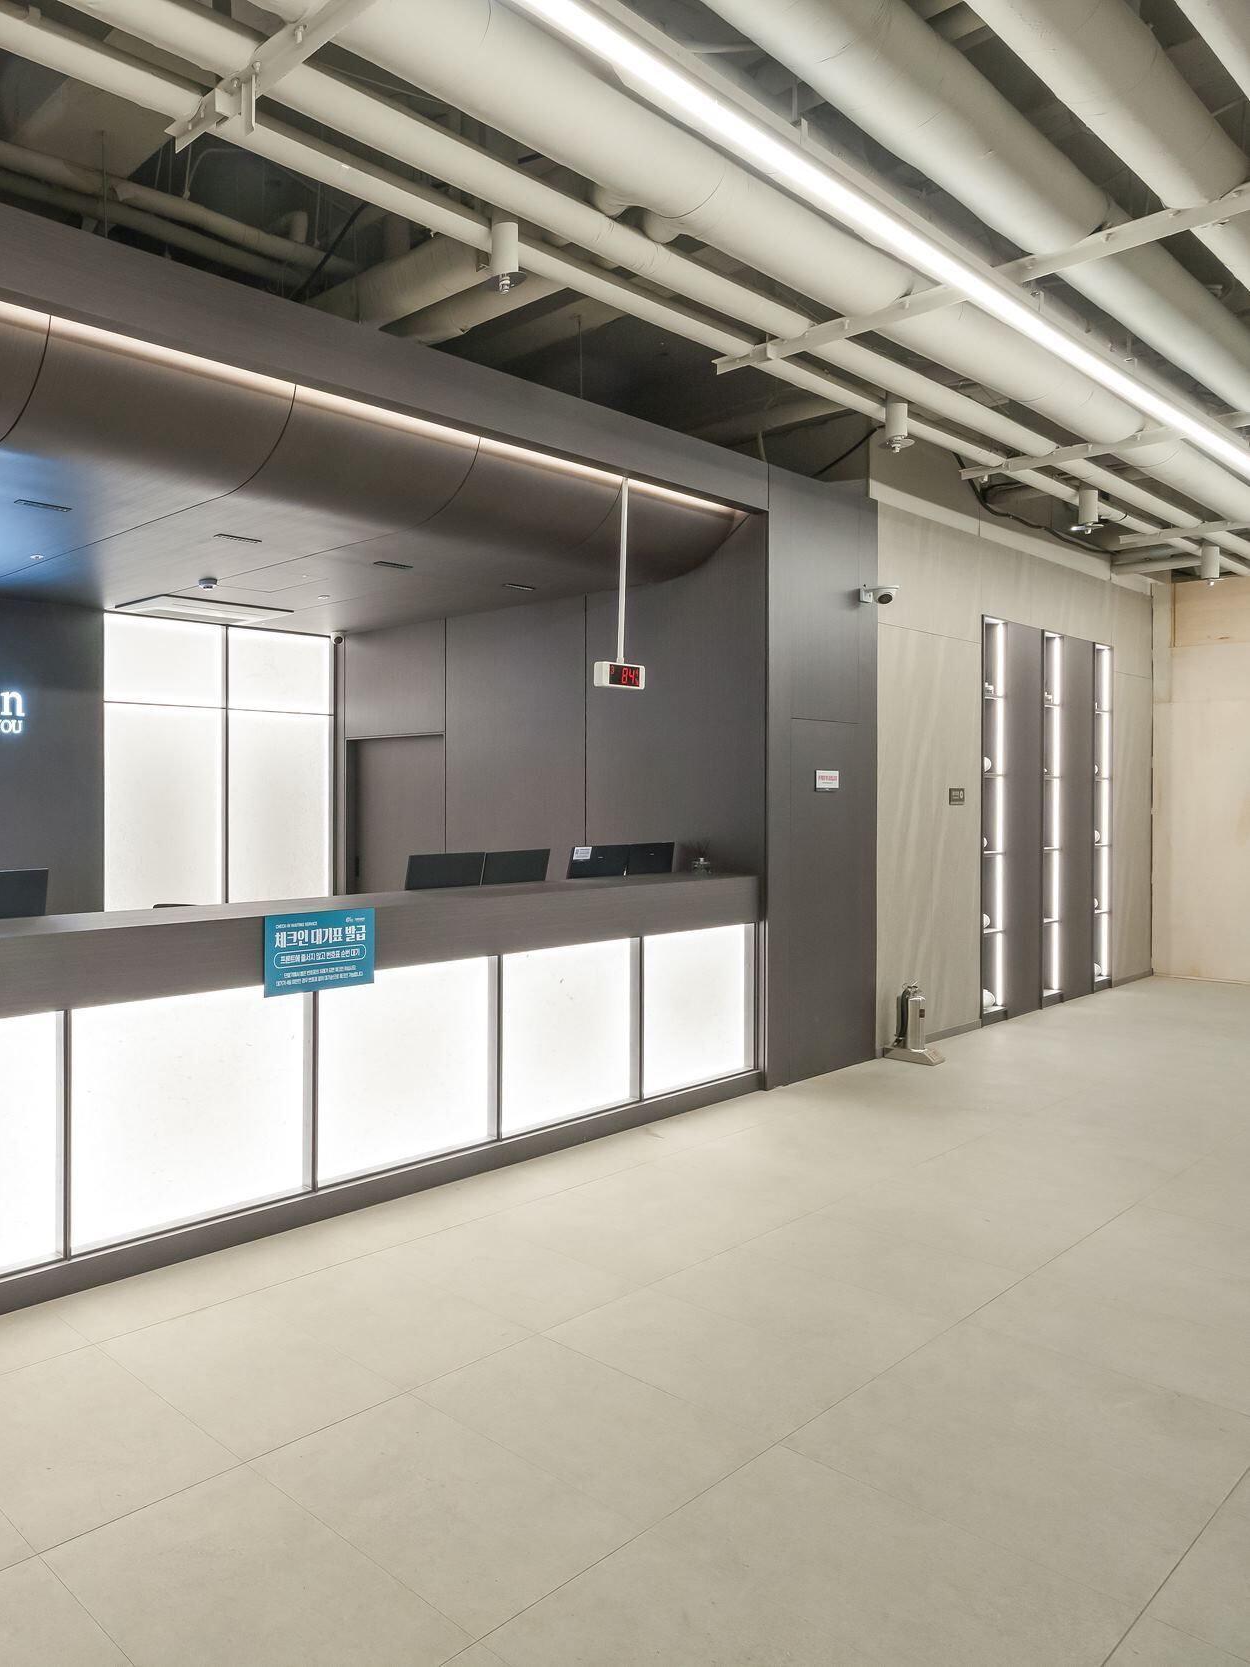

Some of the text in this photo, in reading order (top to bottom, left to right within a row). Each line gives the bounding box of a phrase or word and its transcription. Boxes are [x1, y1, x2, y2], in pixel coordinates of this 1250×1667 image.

[274, 924, 367, 948] 체크인 대기표 발급
